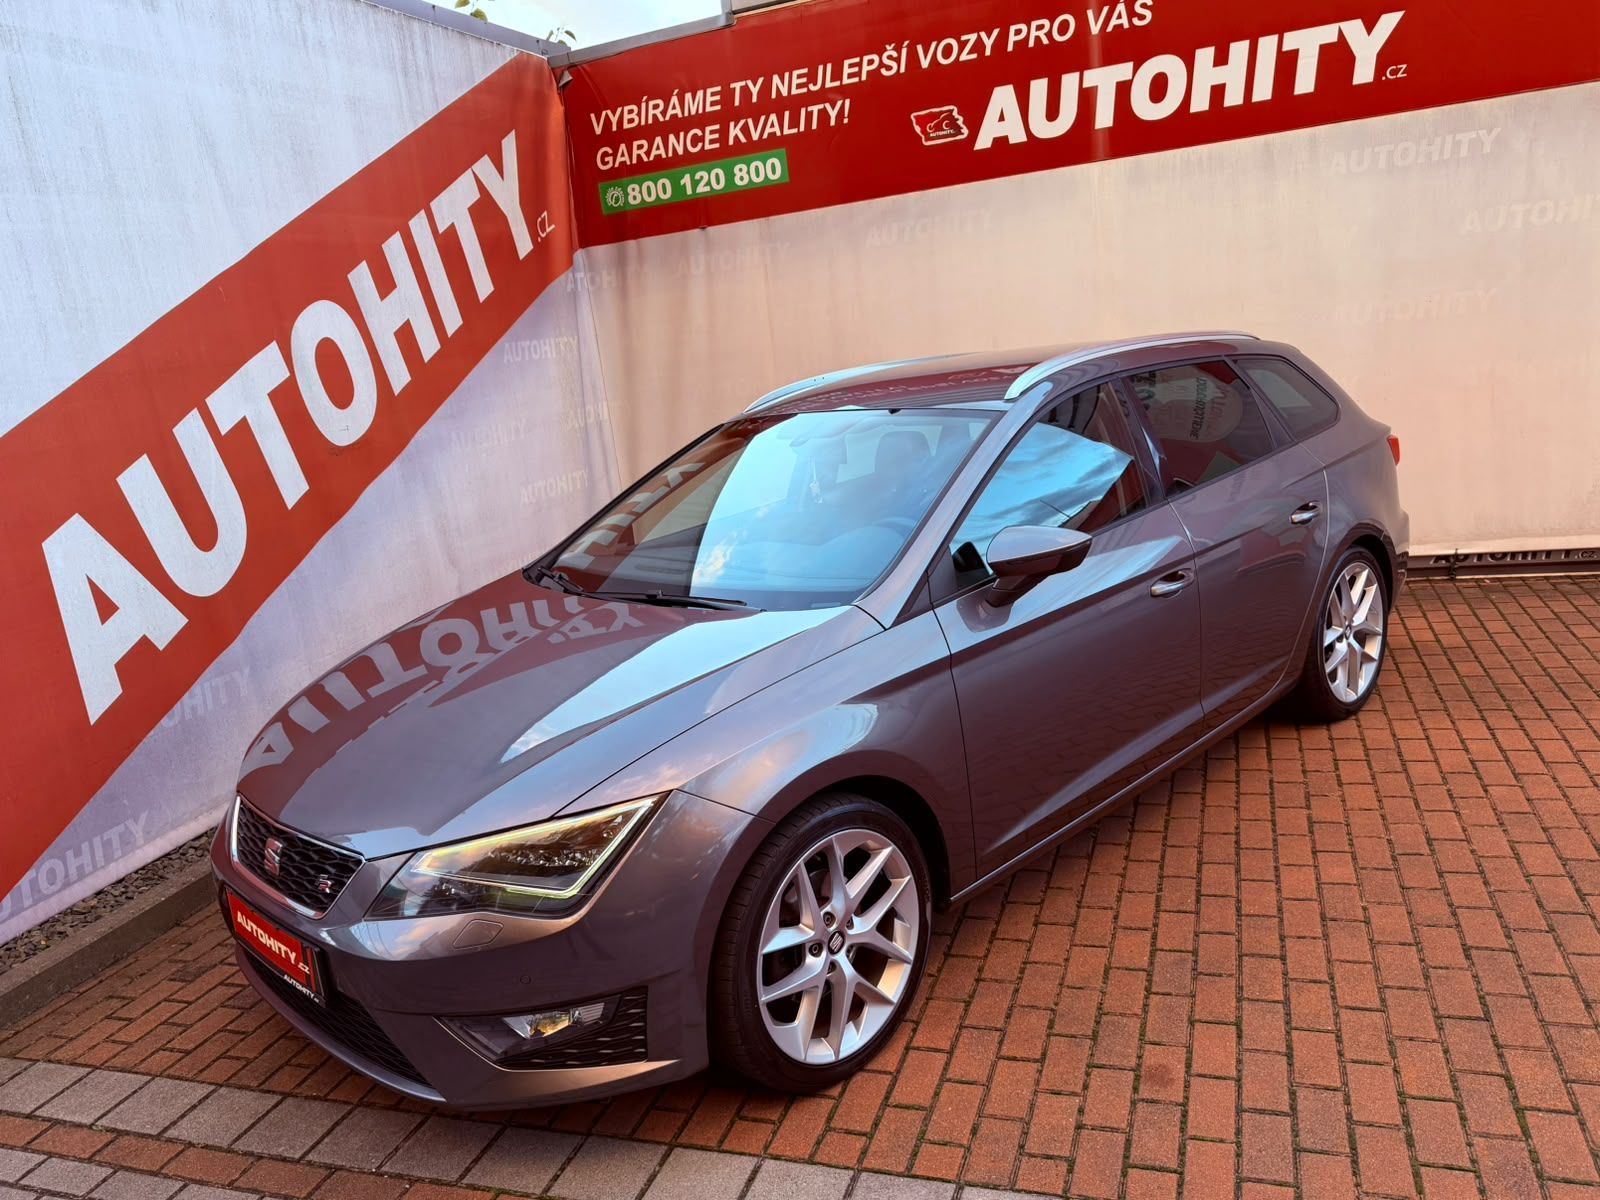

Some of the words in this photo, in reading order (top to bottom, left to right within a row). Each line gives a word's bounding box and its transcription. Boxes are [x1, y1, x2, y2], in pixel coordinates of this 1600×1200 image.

[590, 86, 721, 135] VYBÍRÁME
[729, 78, 764, 107] TY
[771, 40, 911, 99] NEJLEPŠÍ
[916, 28, 1000, 68] VOZY
[1007, 13, 1076, 51] PRO
[1086, 0, 1153, 35] VÁS
[973, 10, 1406, 150] AUTOHITY
[596, 124, 720, 170] GARANCE
[728, 99, 851, 146] KVALITY!
[627, 178, 673, 205] 800
[680, 168, 726, 196] 120
[733, 157, 782, 186] 800
[1459, 193, 1600, 235] AUTOHI
[42, 129, 534, 726] AUTOHITY
[237, 911, 297, 965] AUTOHITY
[283, 974, 315, 998] AUTOHITY
